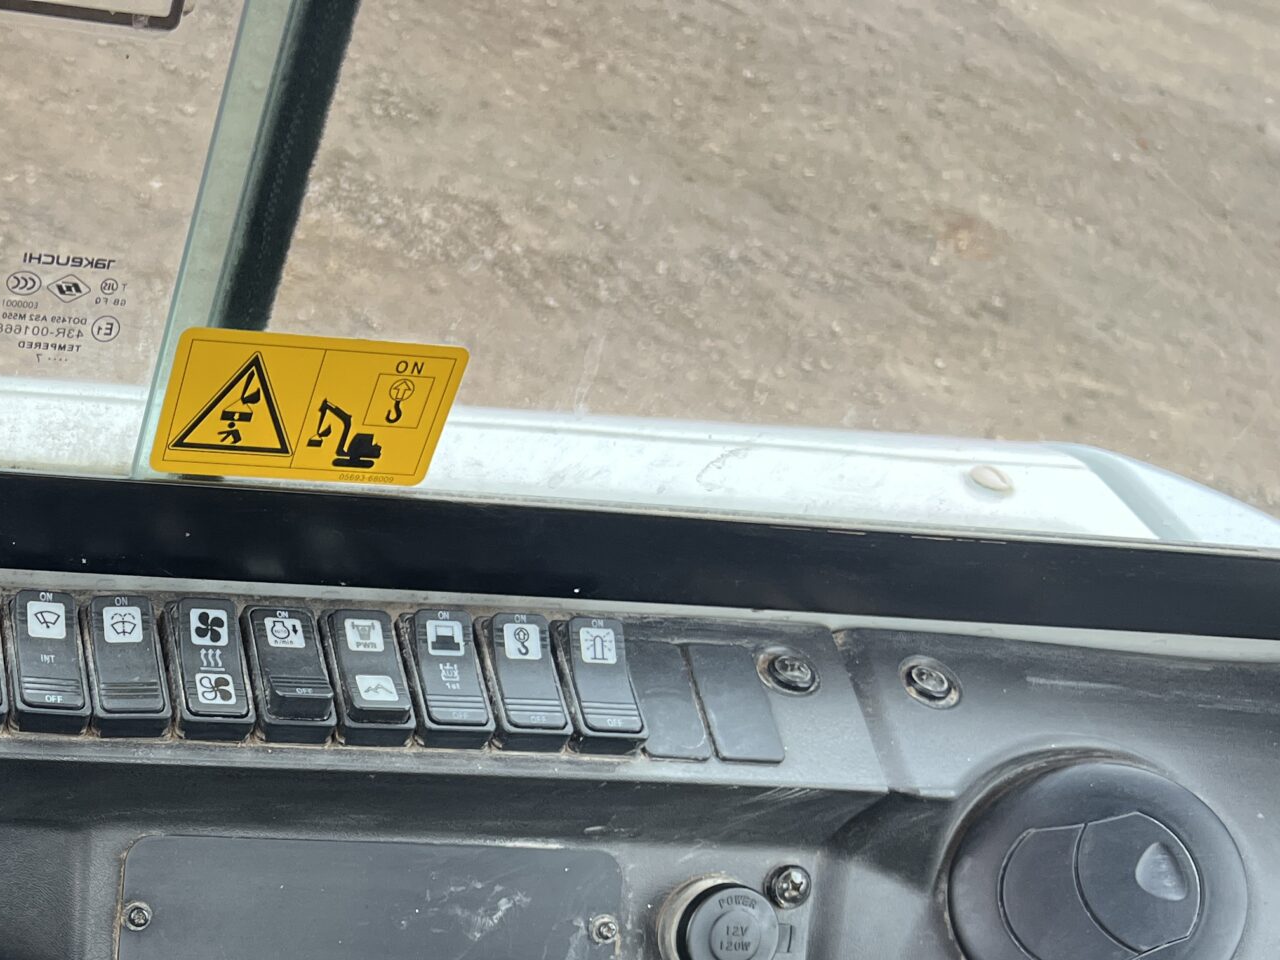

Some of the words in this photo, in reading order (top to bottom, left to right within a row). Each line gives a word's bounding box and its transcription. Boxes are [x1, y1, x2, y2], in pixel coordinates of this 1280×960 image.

[395, 360, 425, 375] ON
[39, 592, 53, 602] ON
[114, 597, 128, 606] ON
[437, 611, 450, 620] ON
[514, 615, 527, 623] ON
[591, 619, 604, 627] ON
[40, 653, 56, 663] INT
[45, 695, 63, 703] OFF
[718, 894, 757, 910] POWER
[726, 925, 748, 936] 12V
[720, 940, 751, 951] 120W
